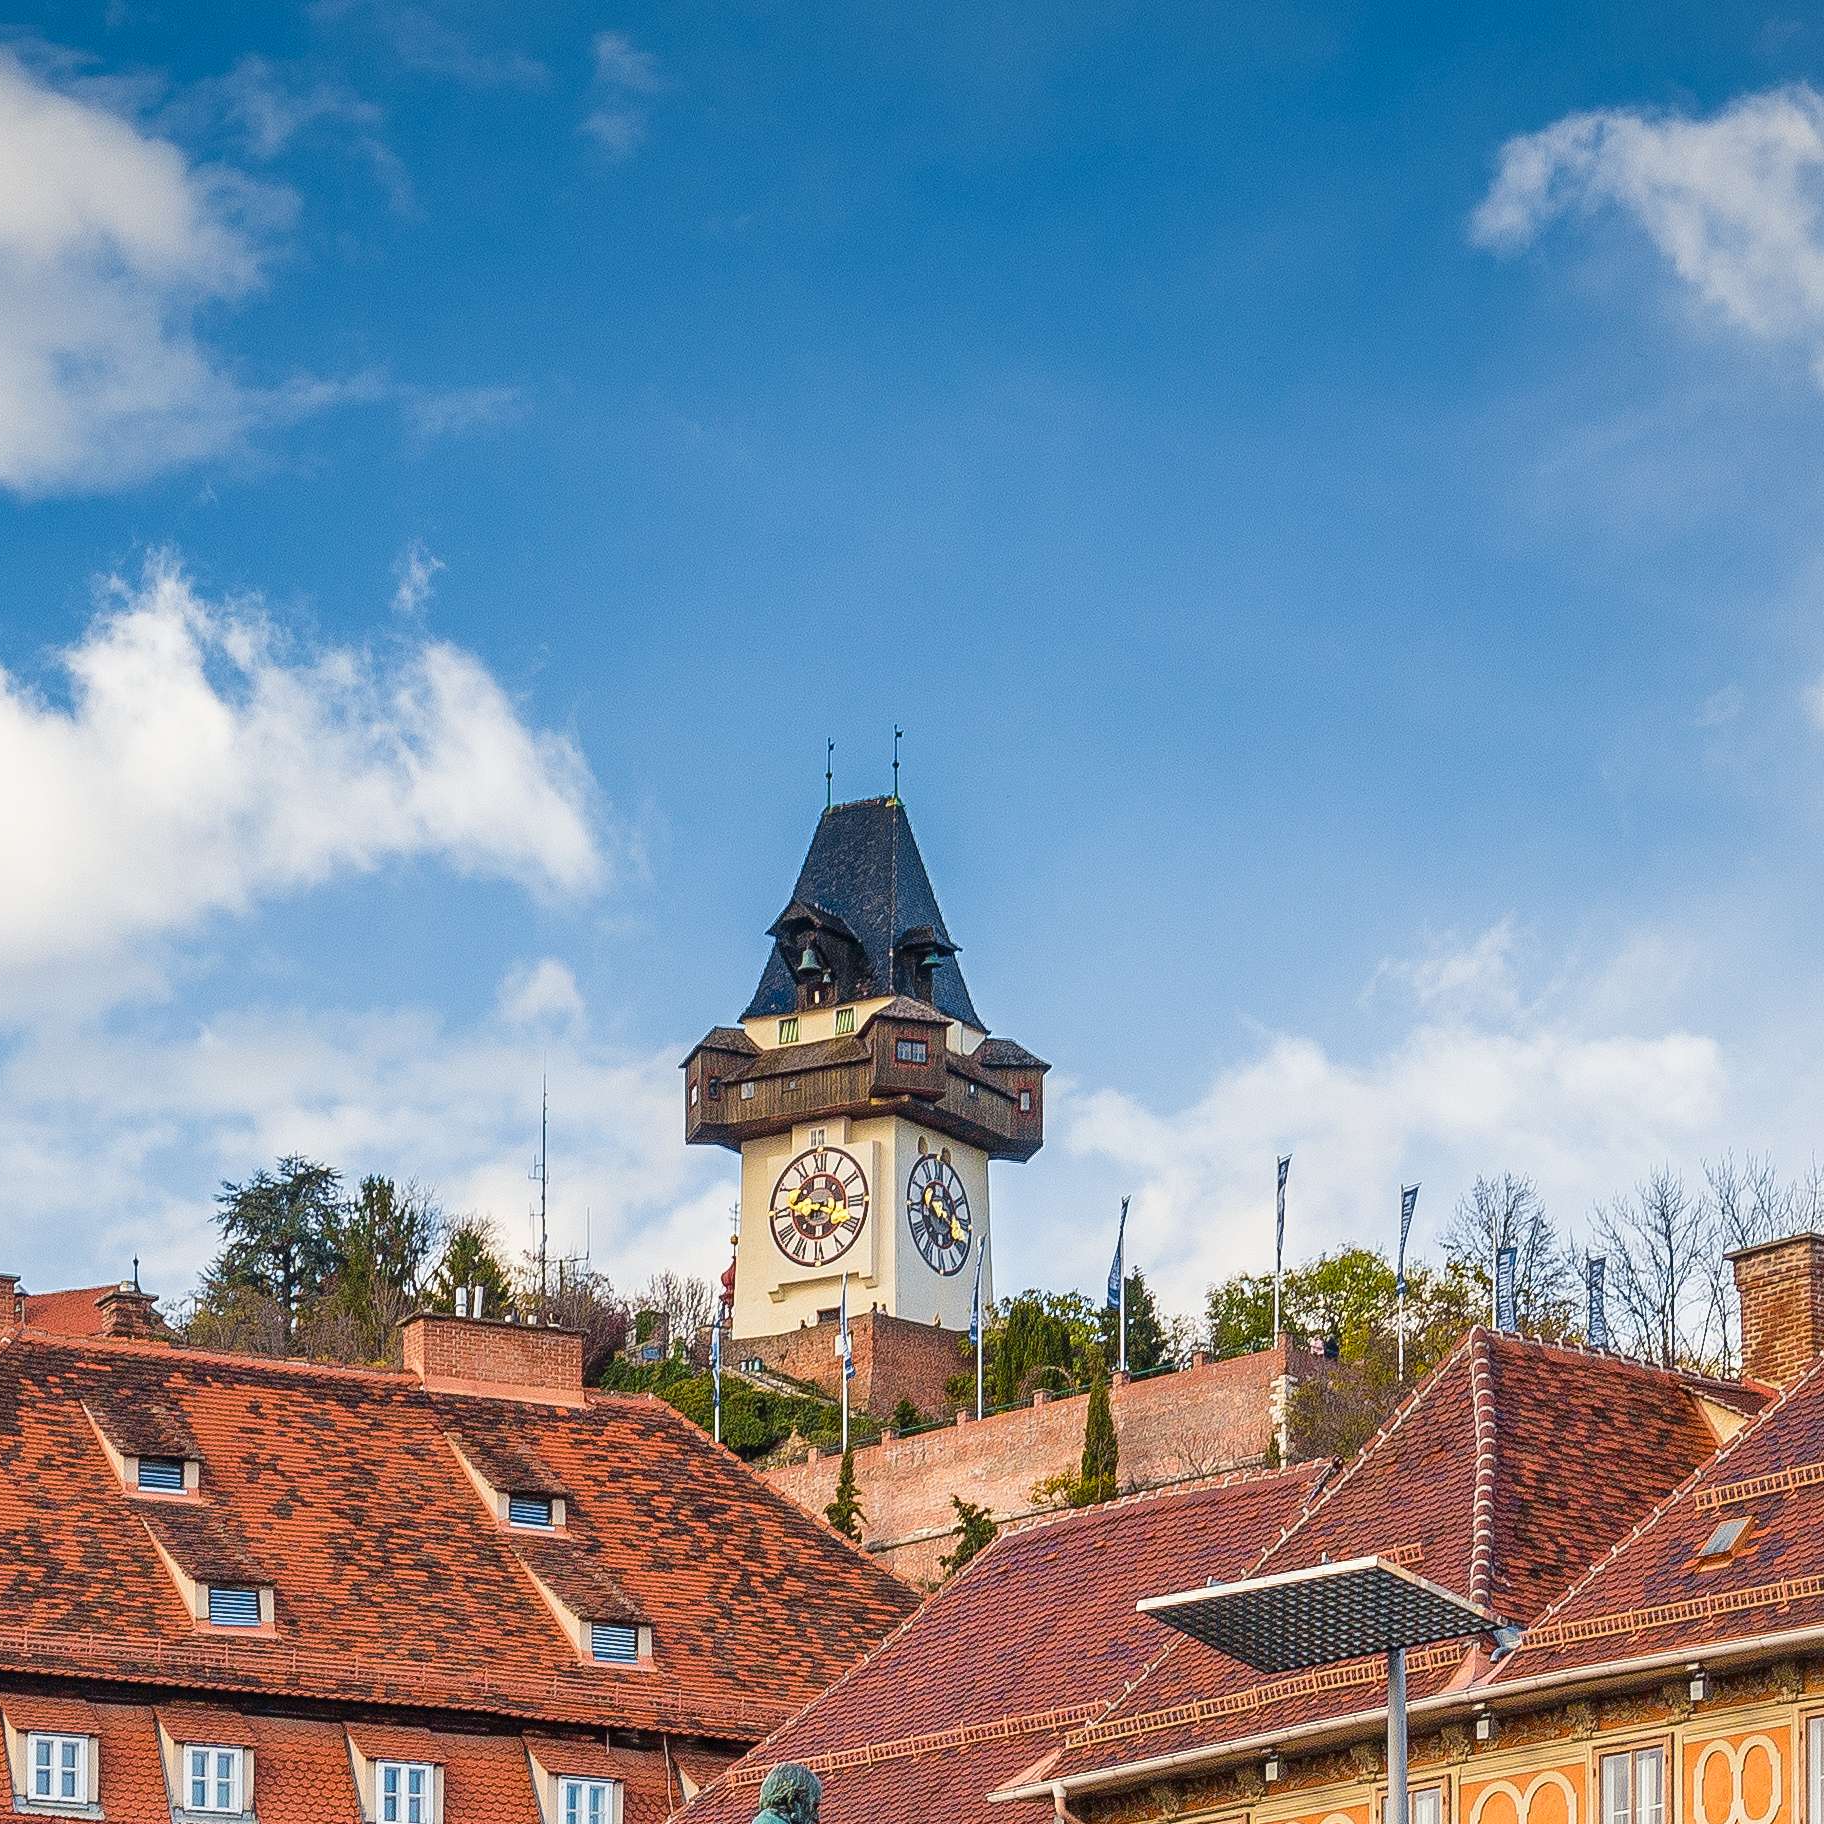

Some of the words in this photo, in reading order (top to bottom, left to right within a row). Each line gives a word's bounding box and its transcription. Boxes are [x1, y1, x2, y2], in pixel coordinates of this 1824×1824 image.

[812, 1151, 829, 1174] XII
[842, 1169, 860, 1189] II
[847, 1192, 865, 1209] III
